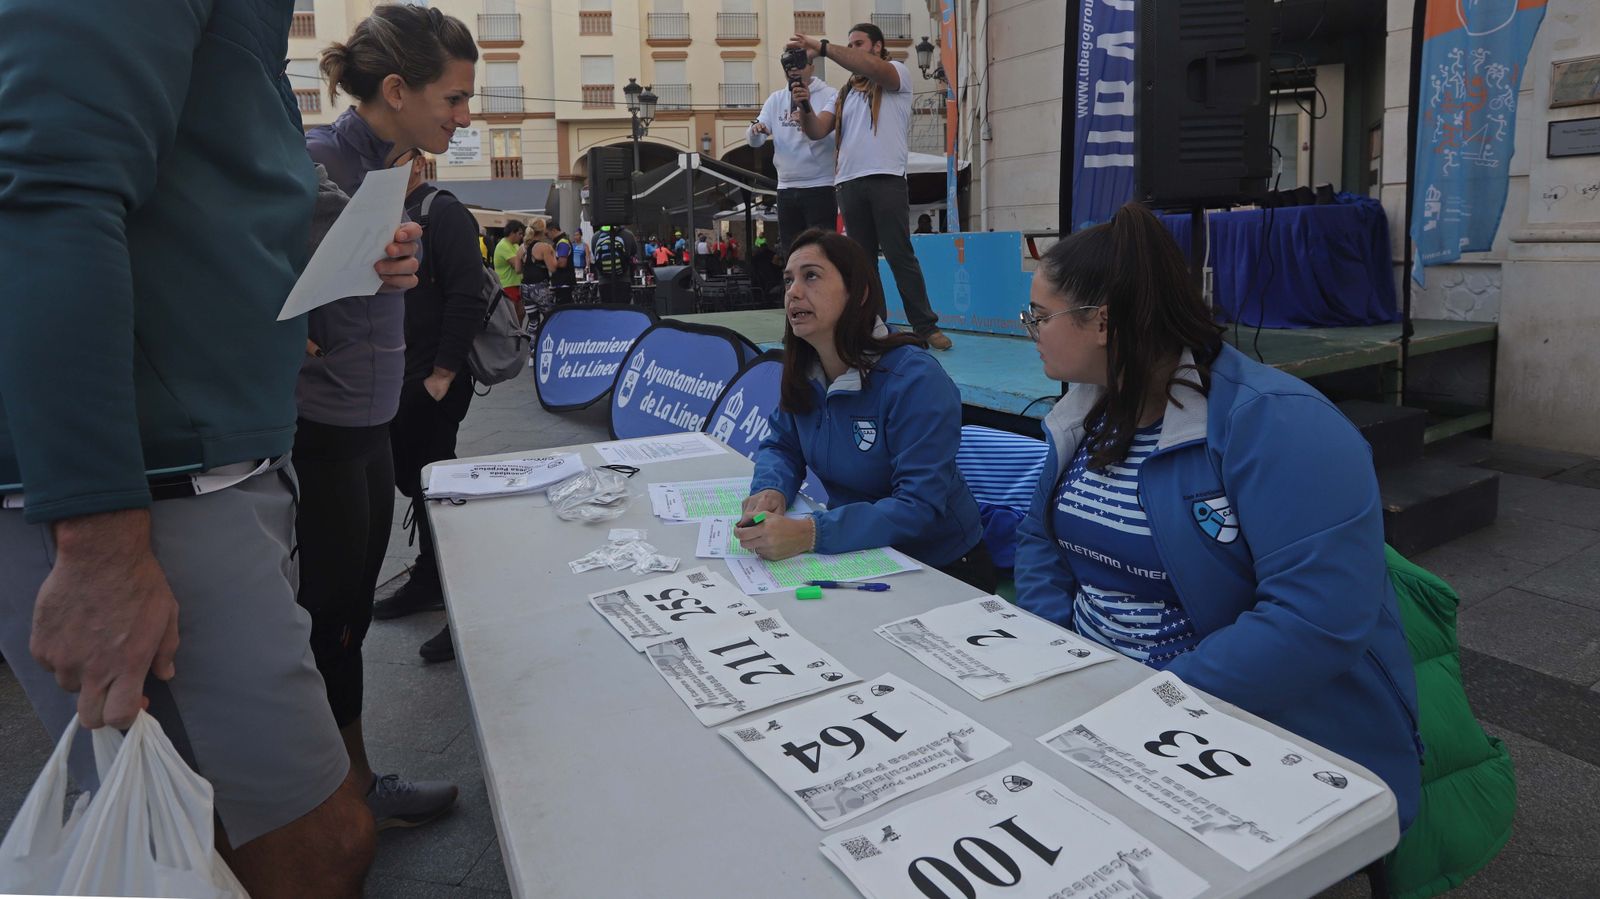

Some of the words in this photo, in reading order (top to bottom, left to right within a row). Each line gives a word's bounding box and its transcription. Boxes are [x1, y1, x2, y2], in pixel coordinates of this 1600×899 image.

[555, 336, 636, 360] Ayuntamient
[558, 361, 572, 378] de
[571, 361, 587, 378] La
[585, 359, 620, 377] Línea
[639, 391, 656, 413] de
[654, 396, 671, 420] La
[670, 402, 708, 432] Línea
[1058, 539, 1121, 569] ATLETISMO
[643, 587, 717, 622] 255
[966, 628, 1018, 647] 2
[708, 636, 796, 685] 211
[780, 710, 908, 774] 164
[1144, 729, 1252, 780] 53
[905, 762, 947, 781] Carrera
[1100, 753, 1214, 820] Inmaculada
[1134, 784, 1181, 814] Carrera
[907, 814, 1064, 899] 100
